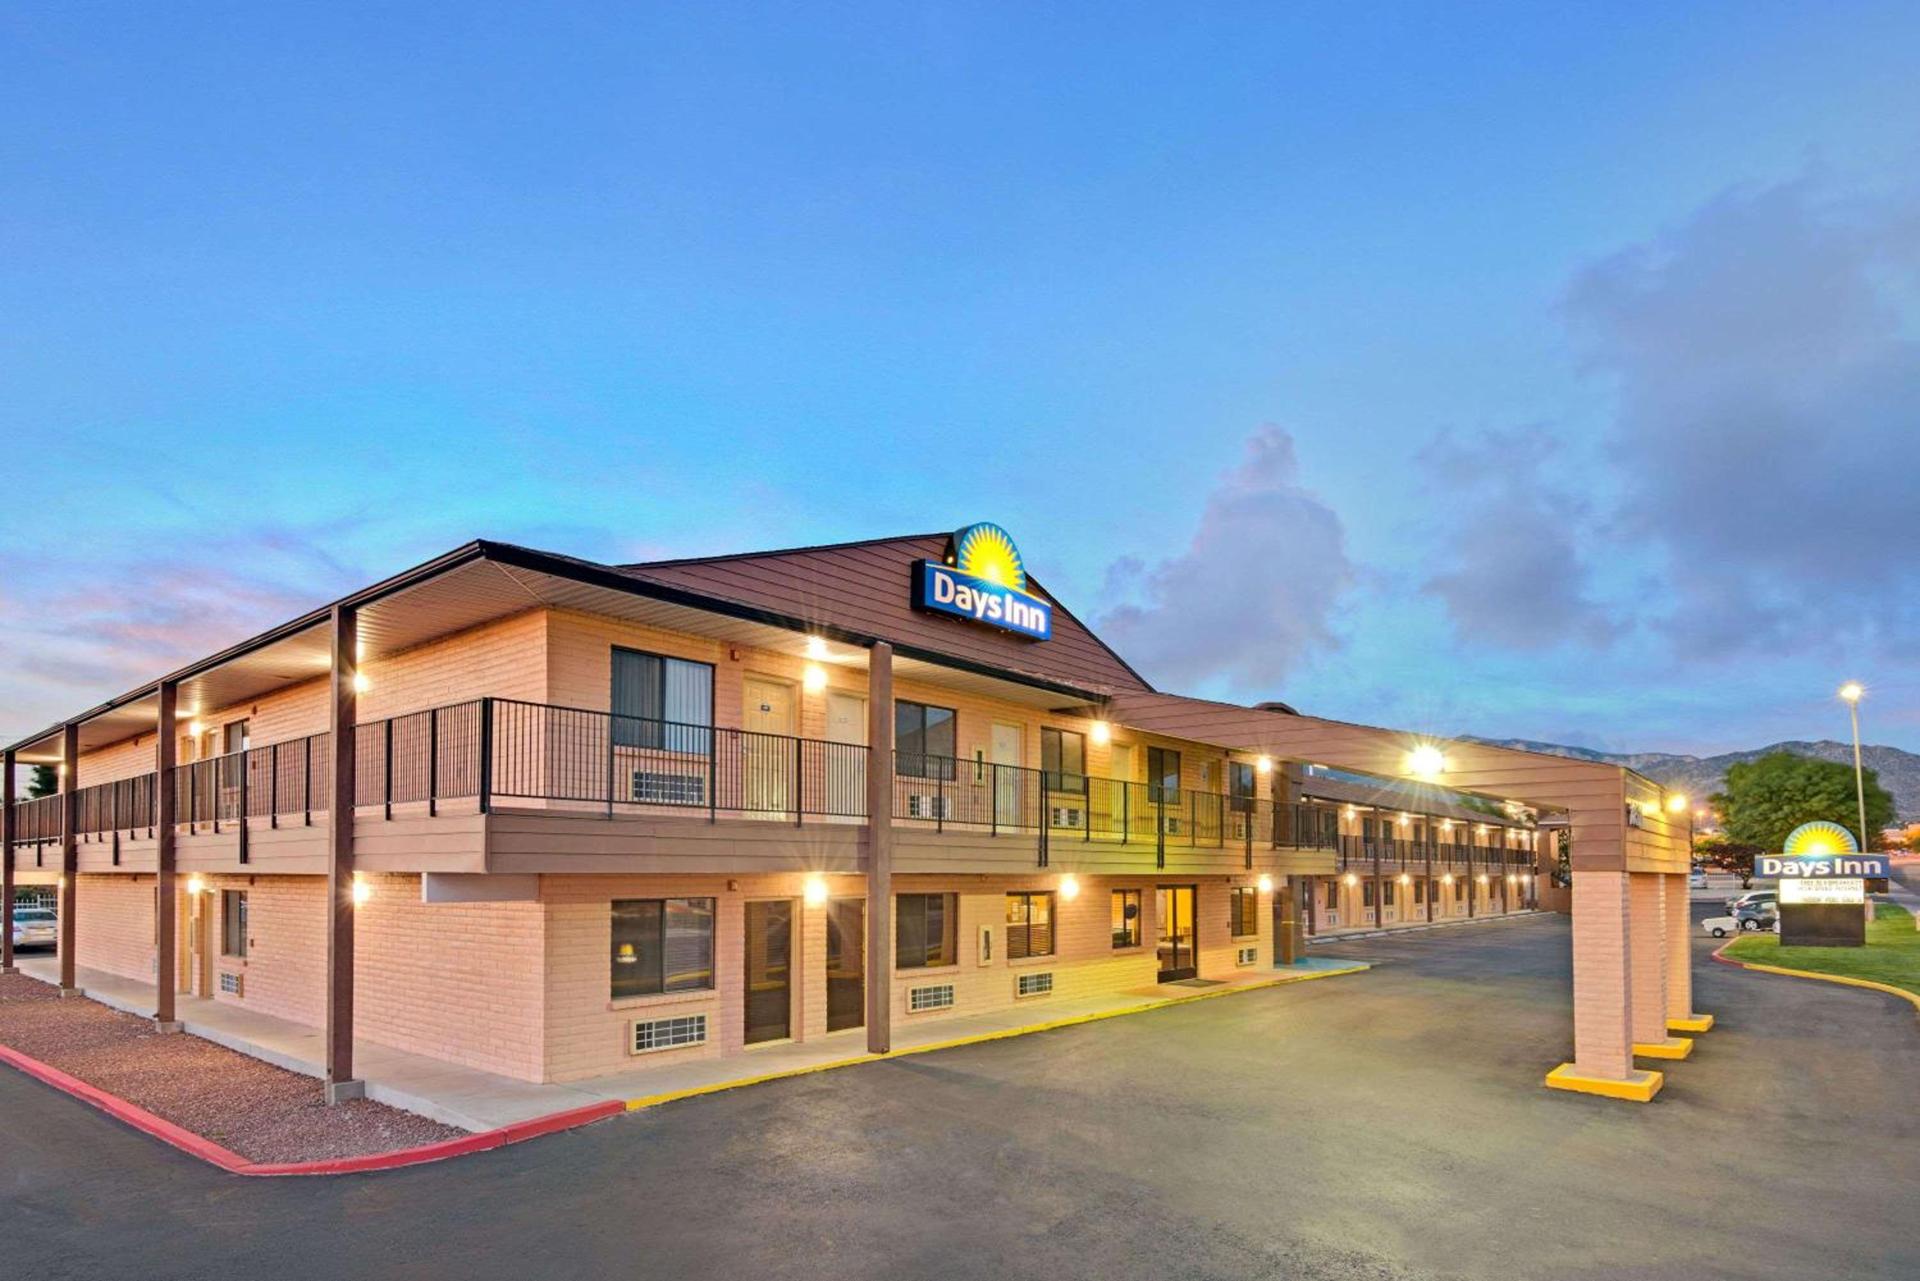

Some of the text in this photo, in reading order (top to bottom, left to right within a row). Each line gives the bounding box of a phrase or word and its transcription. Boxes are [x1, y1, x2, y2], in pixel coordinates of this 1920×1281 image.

[934, 571, 1045, 632] Days Inn
[1763, 858, 1881, 877] Days Inn
